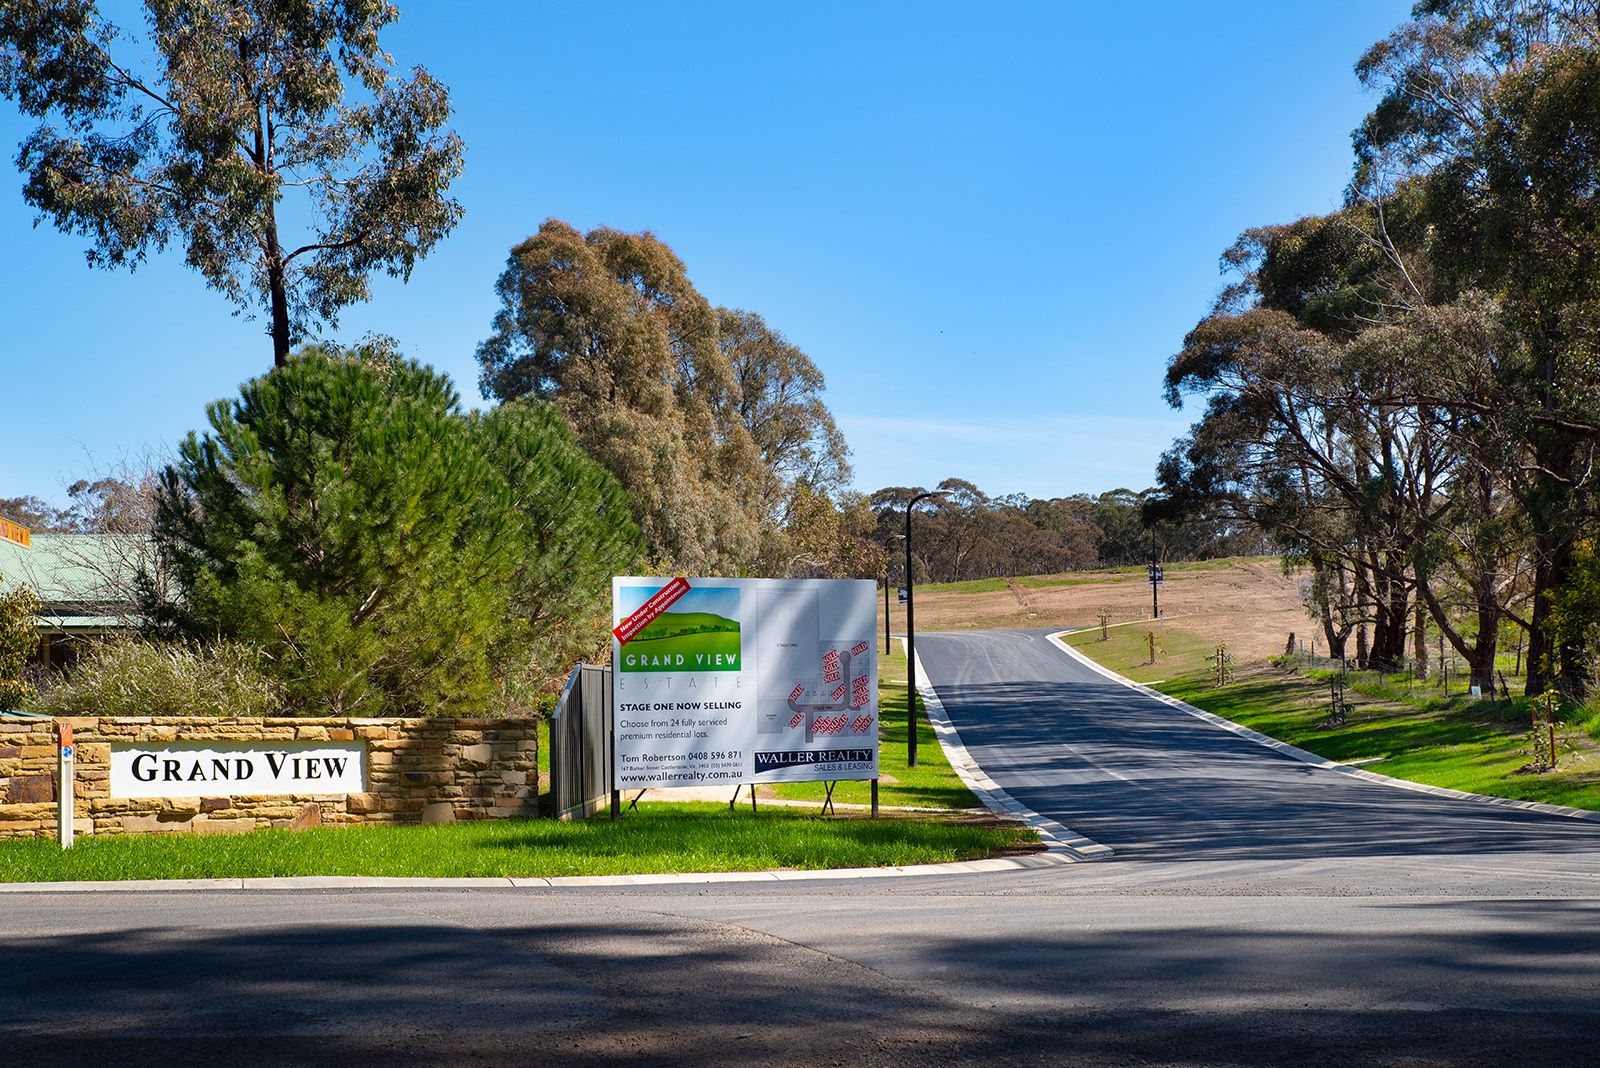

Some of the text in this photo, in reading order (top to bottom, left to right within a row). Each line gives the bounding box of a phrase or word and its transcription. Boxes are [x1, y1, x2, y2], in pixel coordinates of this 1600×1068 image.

[620, 581, 680, 632] Now Under Construction
[621, 585, 687, 640] Inspection by Appointment
[852, 642, 867, 656] SOLD
[626, 654, 736, 666] GRAND VIEW
[822, 651, 838, 664] SOLD
[824, 662, 839, 674] SOLD
[620, 676, 741, 690] ESTATE
[824, 672, 840, 684] SOLD
[852, 676, 868, 688] SOLD
[791, 685, 804, 702] SOLD
[832, 684, 846, 700] SOLD
[853, 685, 868, 698] SOLD
[620, 701, 742, 712] STAGE ONE NOW SELLING
[854, 694, 868, 708] SOLD
[620, 718, 728, 728] Choose from 24 fully serviced
[790, 712, 804, 728] SOLD
[812, 716, 823, 733] SOLD
[820, 718, 831, 734] SOLD
[828, 719, 839, 734] SOLD
[852, 716, 864, 733] SOLD
[861, 716, 874, 733] SOLD
[620, 732, 653, 742] premium
[655, 730, 691, 739] residential
[620, 750, 742, 762] Tom Robertson 0408 596 871
[756, 750, 871, 764] WALLER REALTY
[131, 752, 348, 782] GRAND VIEW
[814, 762, 874, 772] SALES & LEASING
[620, 770, 742, 782] www.wallerrealty.com.au
